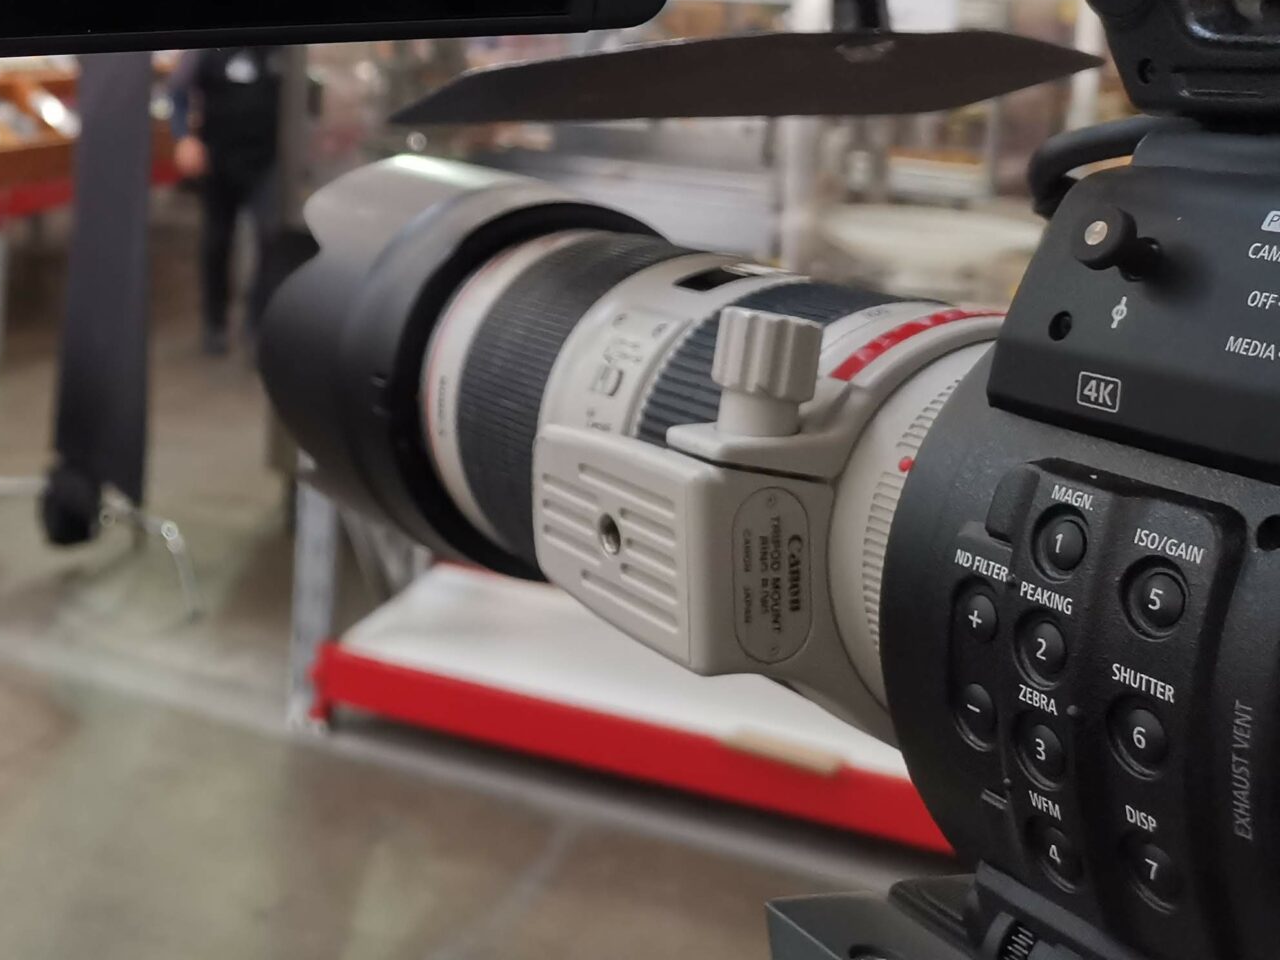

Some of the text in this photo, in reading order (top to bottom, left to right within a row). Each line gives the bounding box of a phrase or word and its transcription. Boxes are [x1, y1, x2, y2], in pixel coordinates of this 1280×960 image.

[1247, 290, 1279, 310] OFF
[1225, 335, 1275, 361] MEDIA
[1081, 379, 1115, 407] 4K
[1051, 484, 1094, 511] MAGN.
[1055, 533, 1064, 554] 1
[1134, 528, 1204, 565] ISO/GAIN
[770, 516, 782, 634] TRIPOD MOUNT
[787, 534, 804, 612] Canon
[954, 549, 1009, 583] ND FILTER
[1019, 581, 1073, 615] PEAKING
[1147, 587, 1164, 611] 5
[1035, 637, 1047, 661] 2
[1111, 662, 1175, 704] SHUTTER
[1018, 683, 1058, 716] ZEBRA
[1034, 738, 1046, 761] 3
[1132, 726, 1147, 749] 6
[1231, 699, 1254, 841] EXHAUST VENT
[1028, 790, 1062, 821] WFM
[1125, 804, 1158, 833] DISP
[1049, 843, 1062, 865] 4
[1144, 858, 1158, 880] 7
